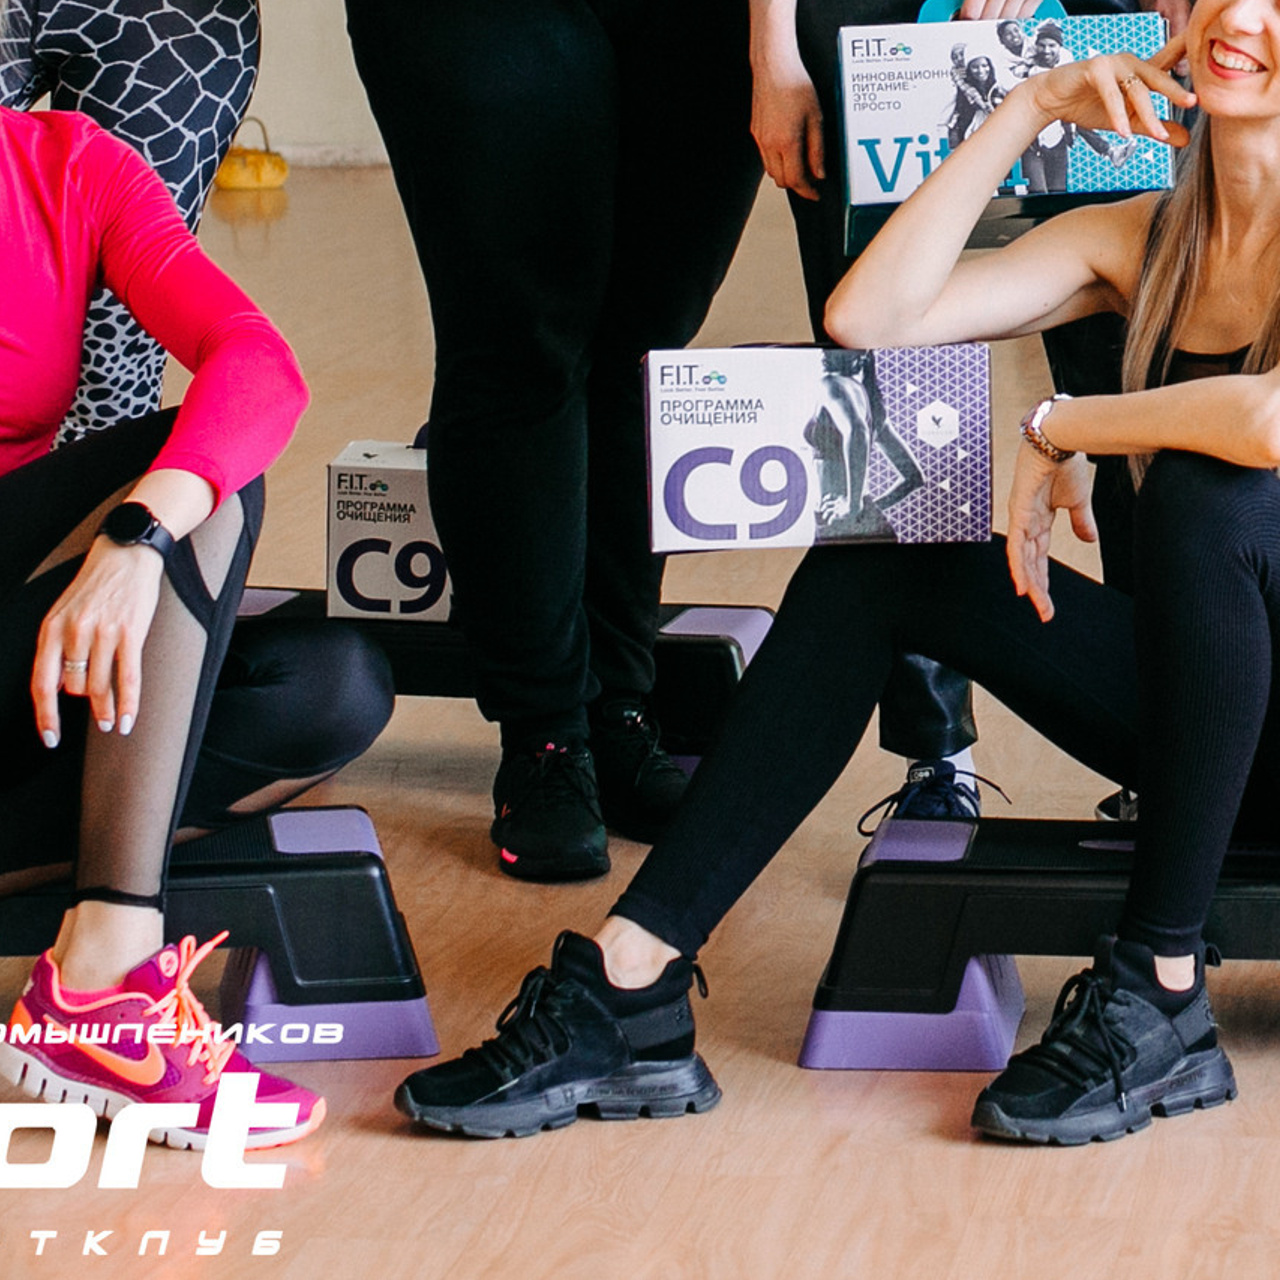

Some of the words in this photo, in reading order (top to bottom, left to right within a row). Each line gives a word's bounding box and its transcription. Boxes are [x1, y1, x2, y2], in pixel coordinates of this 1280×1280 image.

[852, 81, 909, 92] ПИТАНИЕ
[853, 93, 877, 102] ЭТО
[853, 101, 902, 112] ПРОСТО
[660, 365, 700, 386] F.I.T.
[660, 399, 765, 412] ПРОГРАММА
[660, 412, 758, 427] ОЧИЩЕНИЯ
[663, 445, 809, 540] C9
[336, 500, 417, 514] ПРОГРАММА
[336, 510, 411, 524] ОЧИЩЕНИЯ
[336, 538, 447, 614] C9
